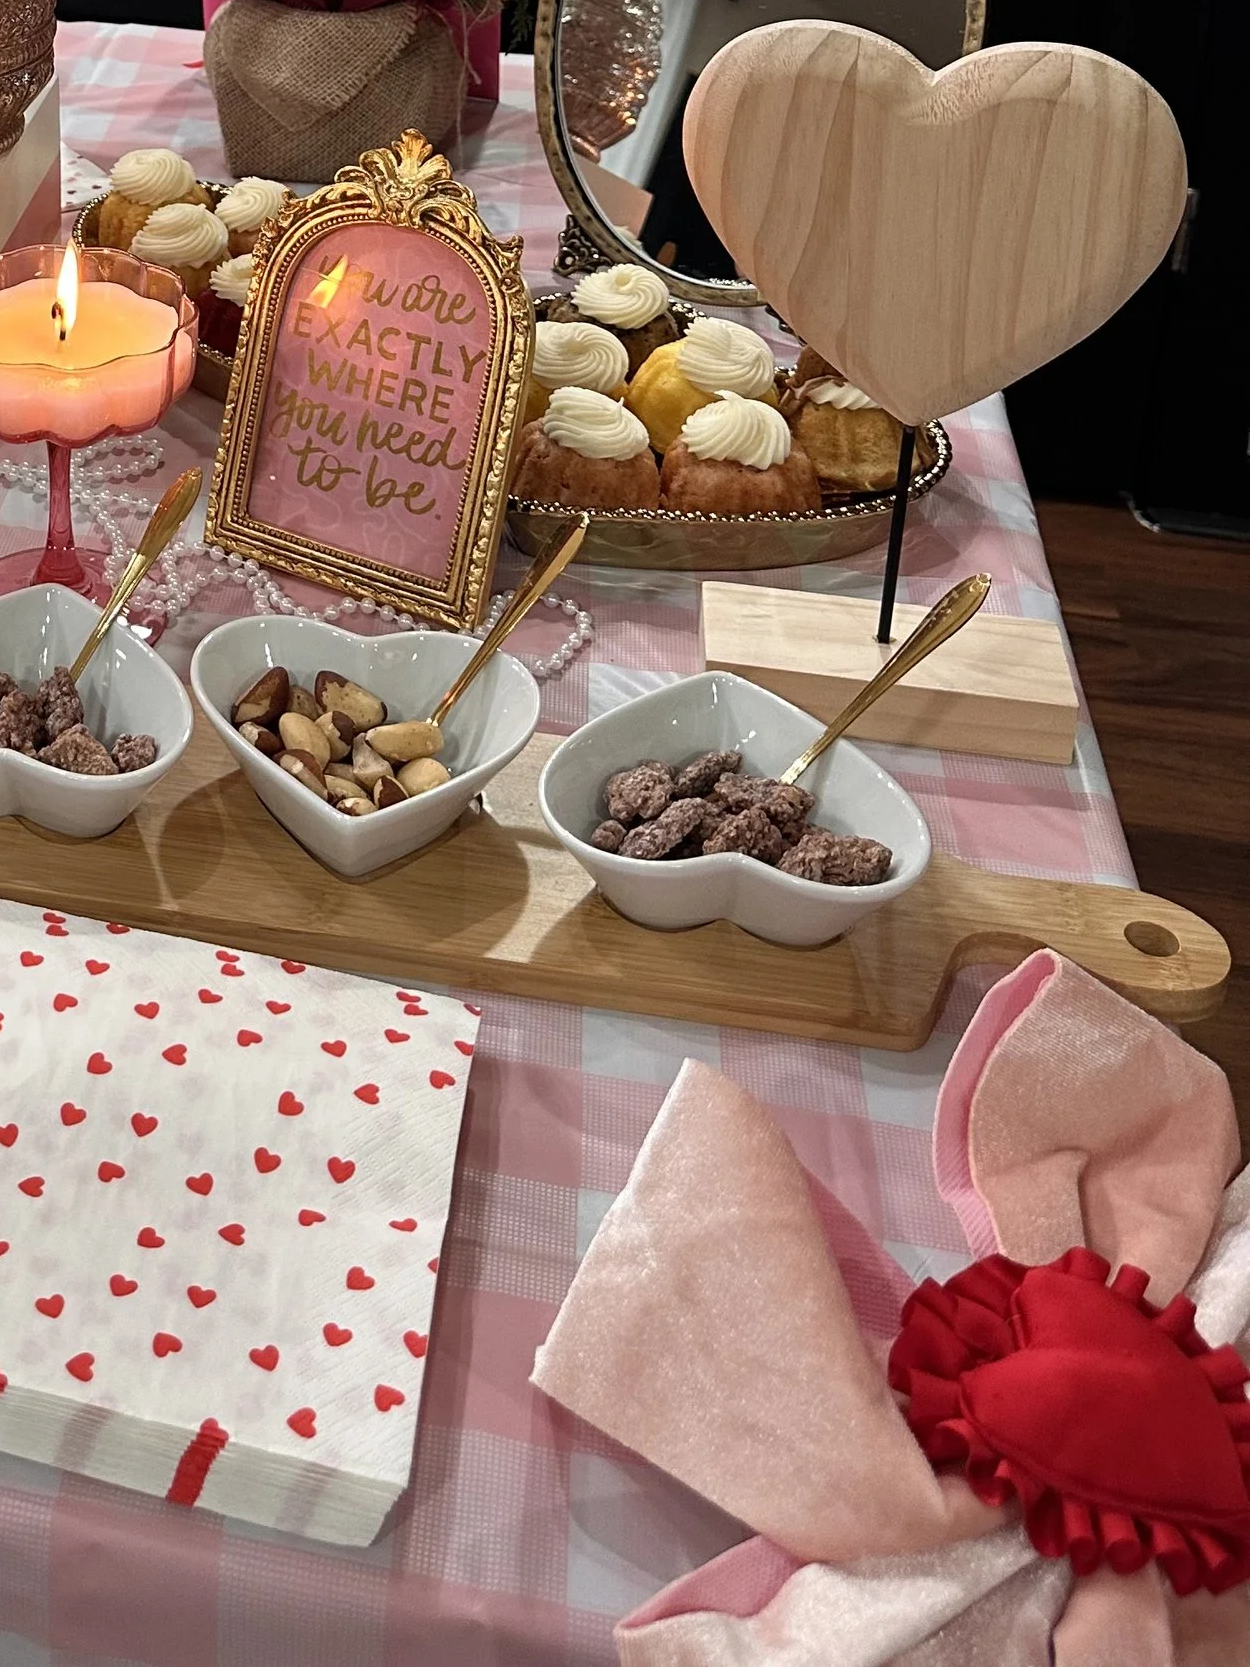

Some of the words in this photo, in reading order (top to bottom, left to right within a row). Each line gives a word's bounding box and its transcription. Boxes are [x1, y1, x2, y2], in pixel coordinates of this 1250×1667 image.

[401, 275, 476, 325] are
[293, 301, 487, 384] EXACTLY
[269, 381, 349, 446] you
[356, 410, 466, 470] need
[307, 348, 455, 424] WHERE
[288, 436, 361, 492] to
[364, 455, 442, 521] be.
